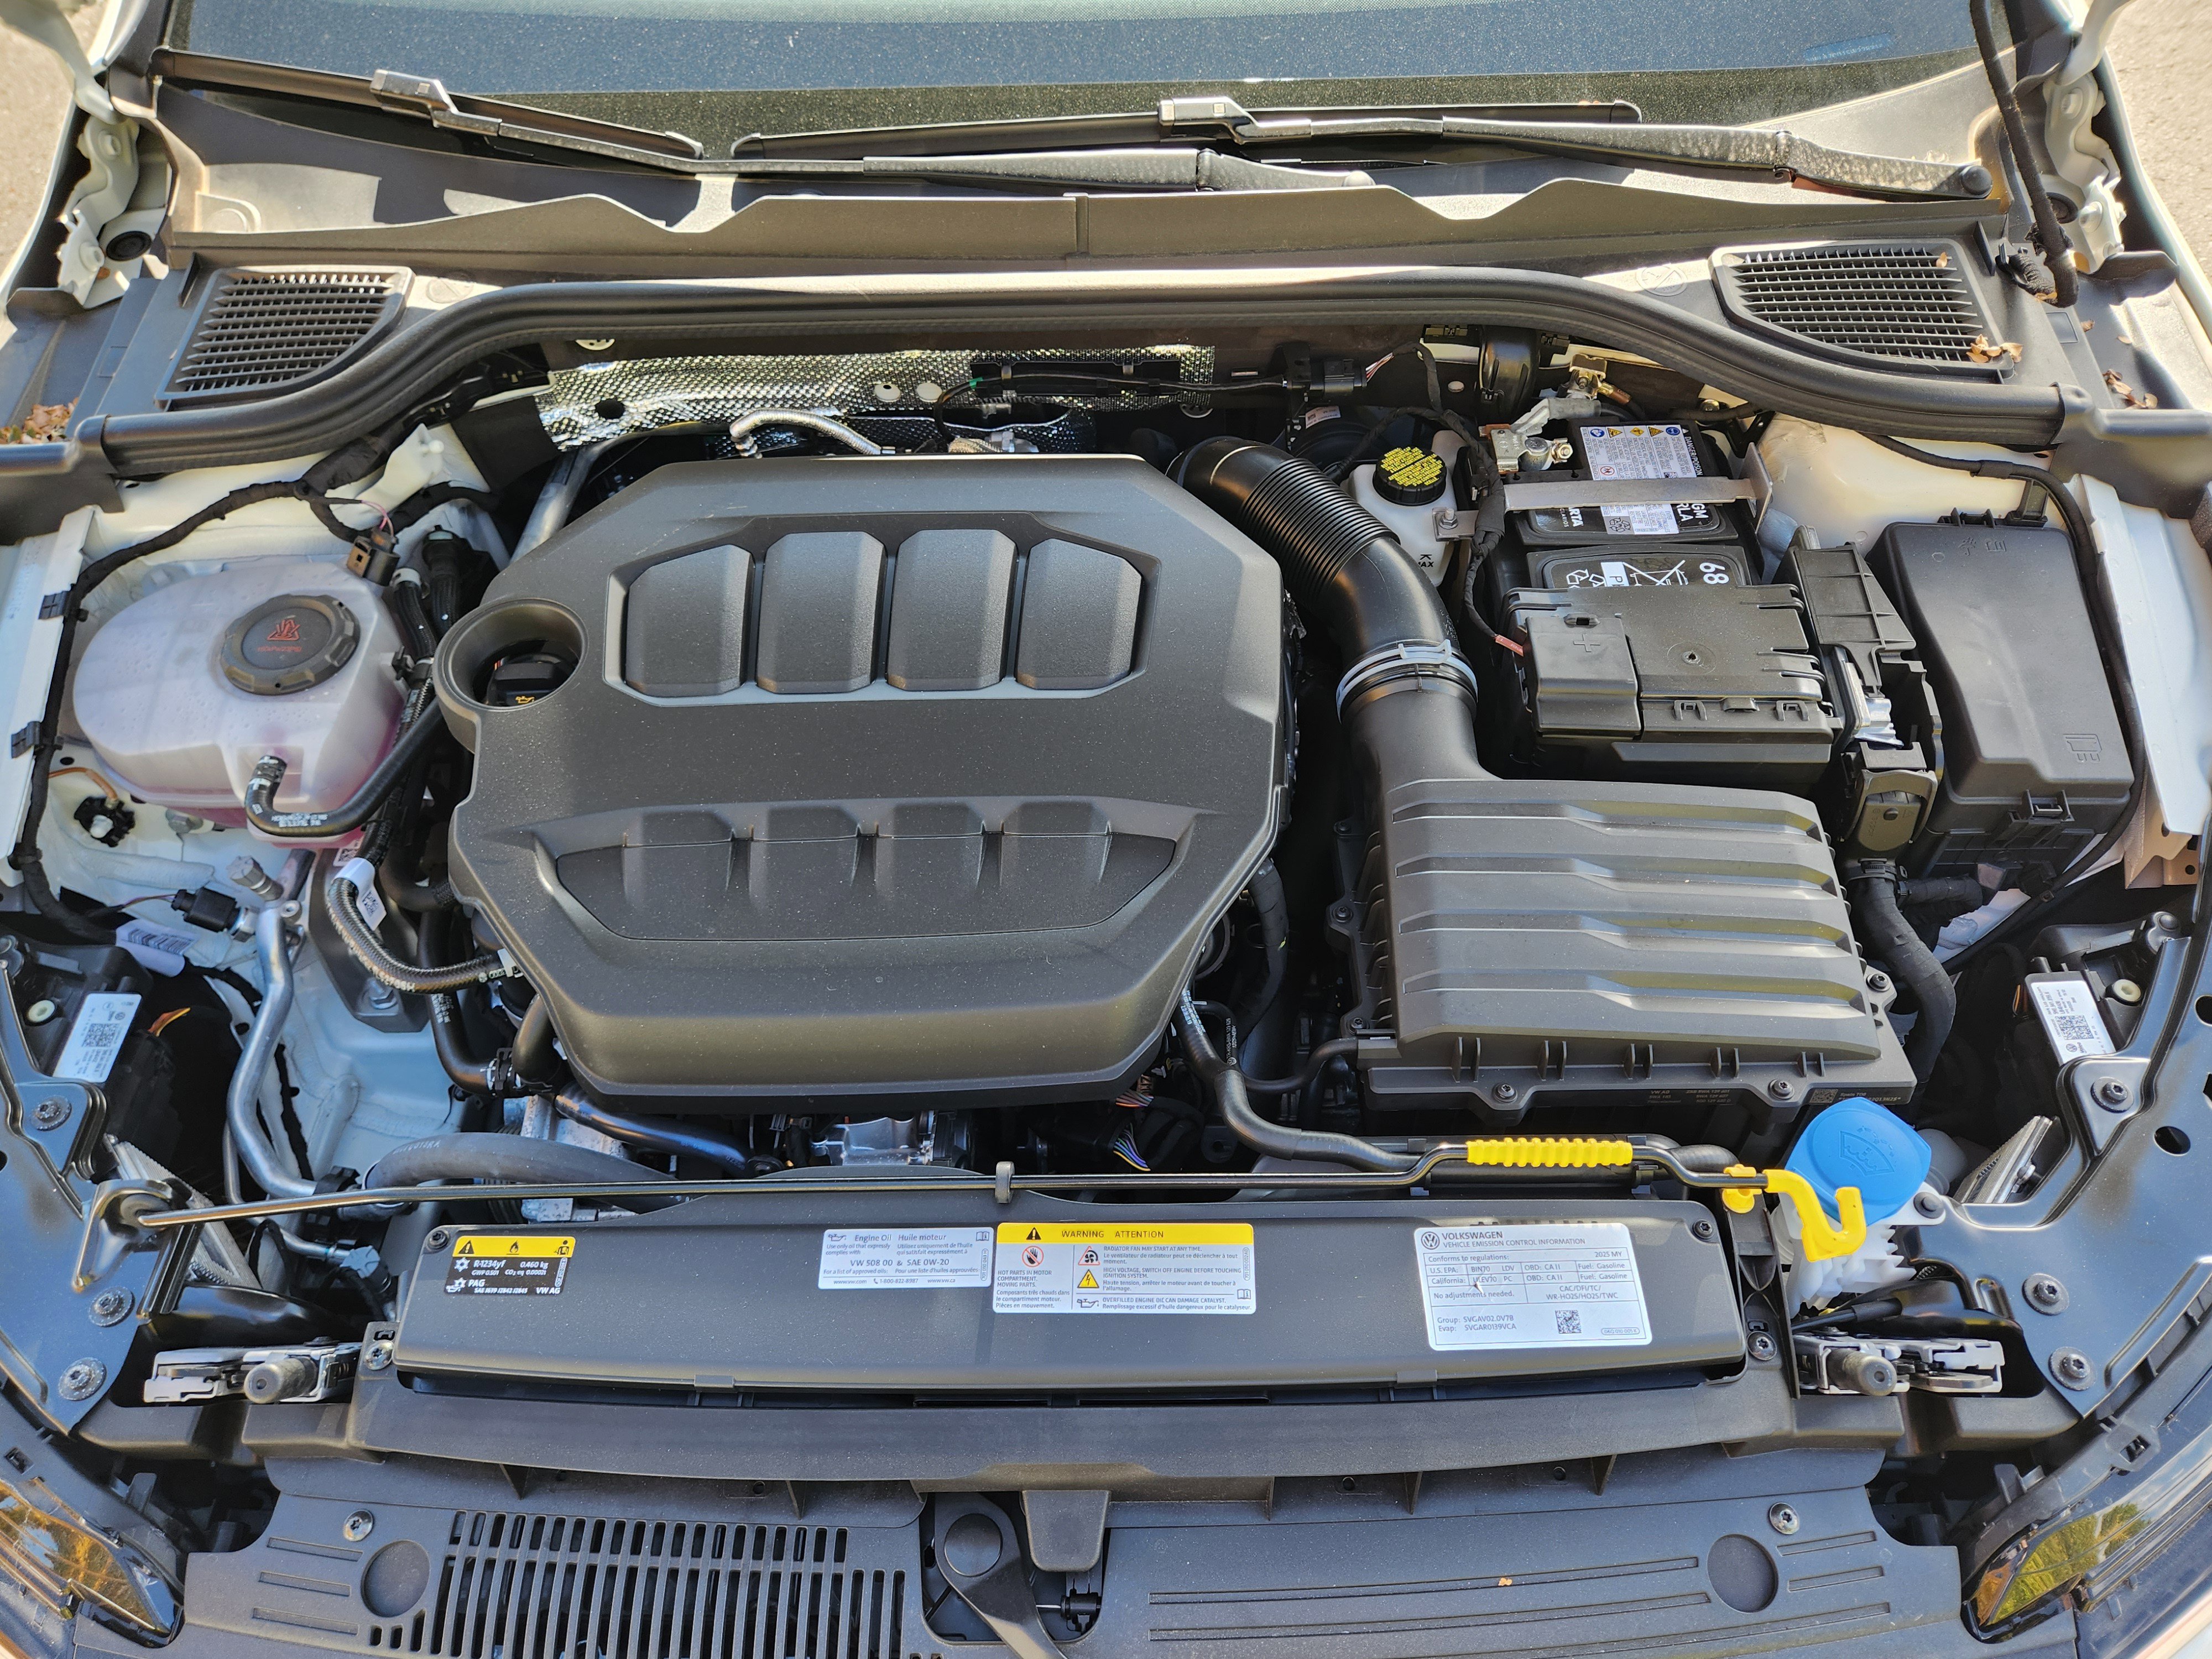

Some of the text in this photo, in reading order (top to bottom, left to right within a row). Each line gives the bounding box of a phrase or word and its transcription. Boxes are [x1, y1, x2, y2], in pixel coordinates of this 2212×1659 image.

[1684, 437, 1703, 475] DANGER/POISON
[1559, 508, 1569, 528] CLARIOS
[1676, 503, 1694, 522] RLA
[1691, 503, 1710, 519] GM
[1442, 1232, 1503, 1240] VOLKSWAGEN
[473, 1260, 506, 1270] R-1234yf
[1445, 1290, 1486, 1298] adjustments
